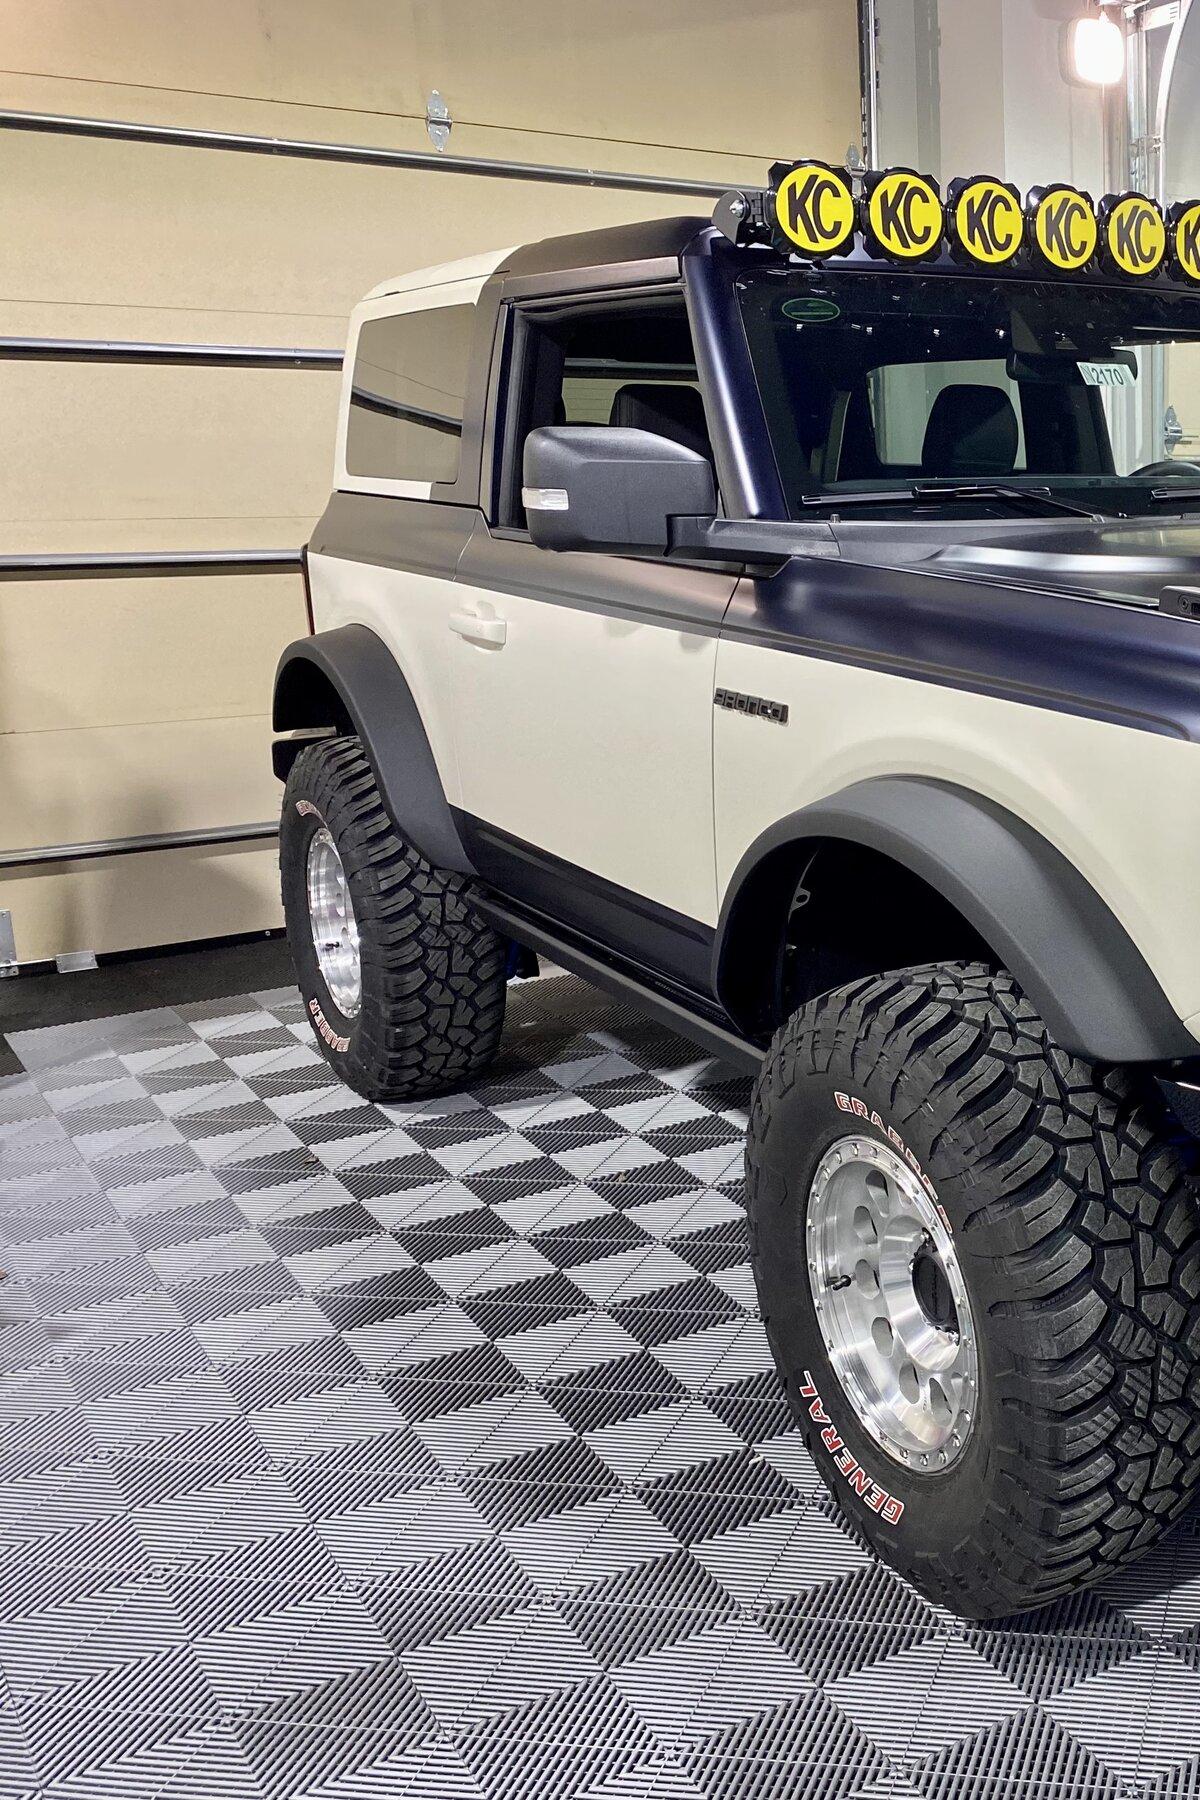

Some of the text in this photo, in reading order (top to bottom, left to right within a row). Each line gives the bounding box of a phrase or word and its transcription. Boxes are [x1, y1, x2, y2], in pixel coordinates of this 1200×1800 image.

[787, 174, 842, 244] KC
[879, 181, 932, 249] KC
[966, 190, 1013, 255] KC
[1045, 198, 1088, 261] KC
[1116, 205, 1156, 267] KC
[799, 1370, 904, 1525] GENERAL
